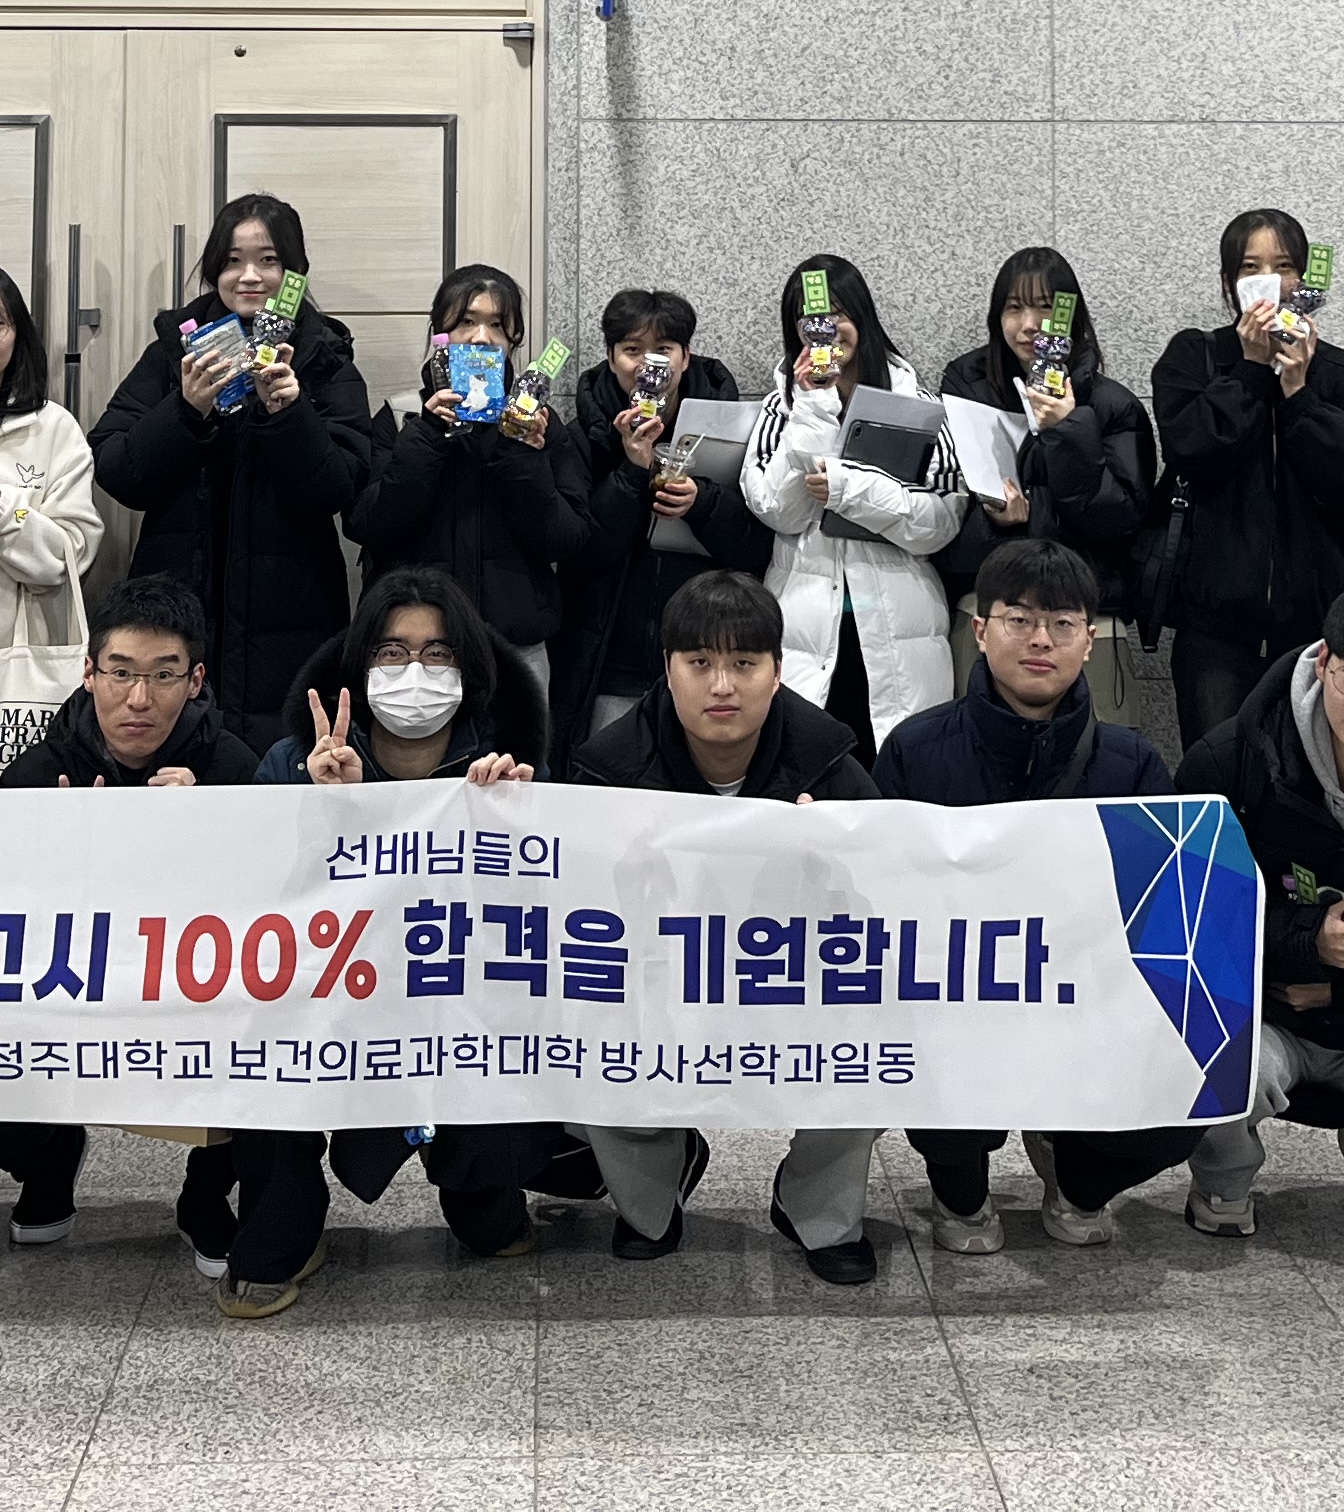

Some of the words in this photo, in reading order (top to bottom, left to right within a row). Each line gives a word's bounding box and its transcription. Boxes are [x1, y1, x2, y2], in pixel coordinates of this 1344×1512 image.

[325, 830, 561, 881] 선배님들의
[138, 909, 377, 1002] 100%
[403, 898, 630, 1004] 합격을
[658, 914, 1076, 1005] 기원합니다.
[229, 1033, 588, 1083] 보건의료과학대학
[600, 1040, 916, 1085] 방사선학과일동
